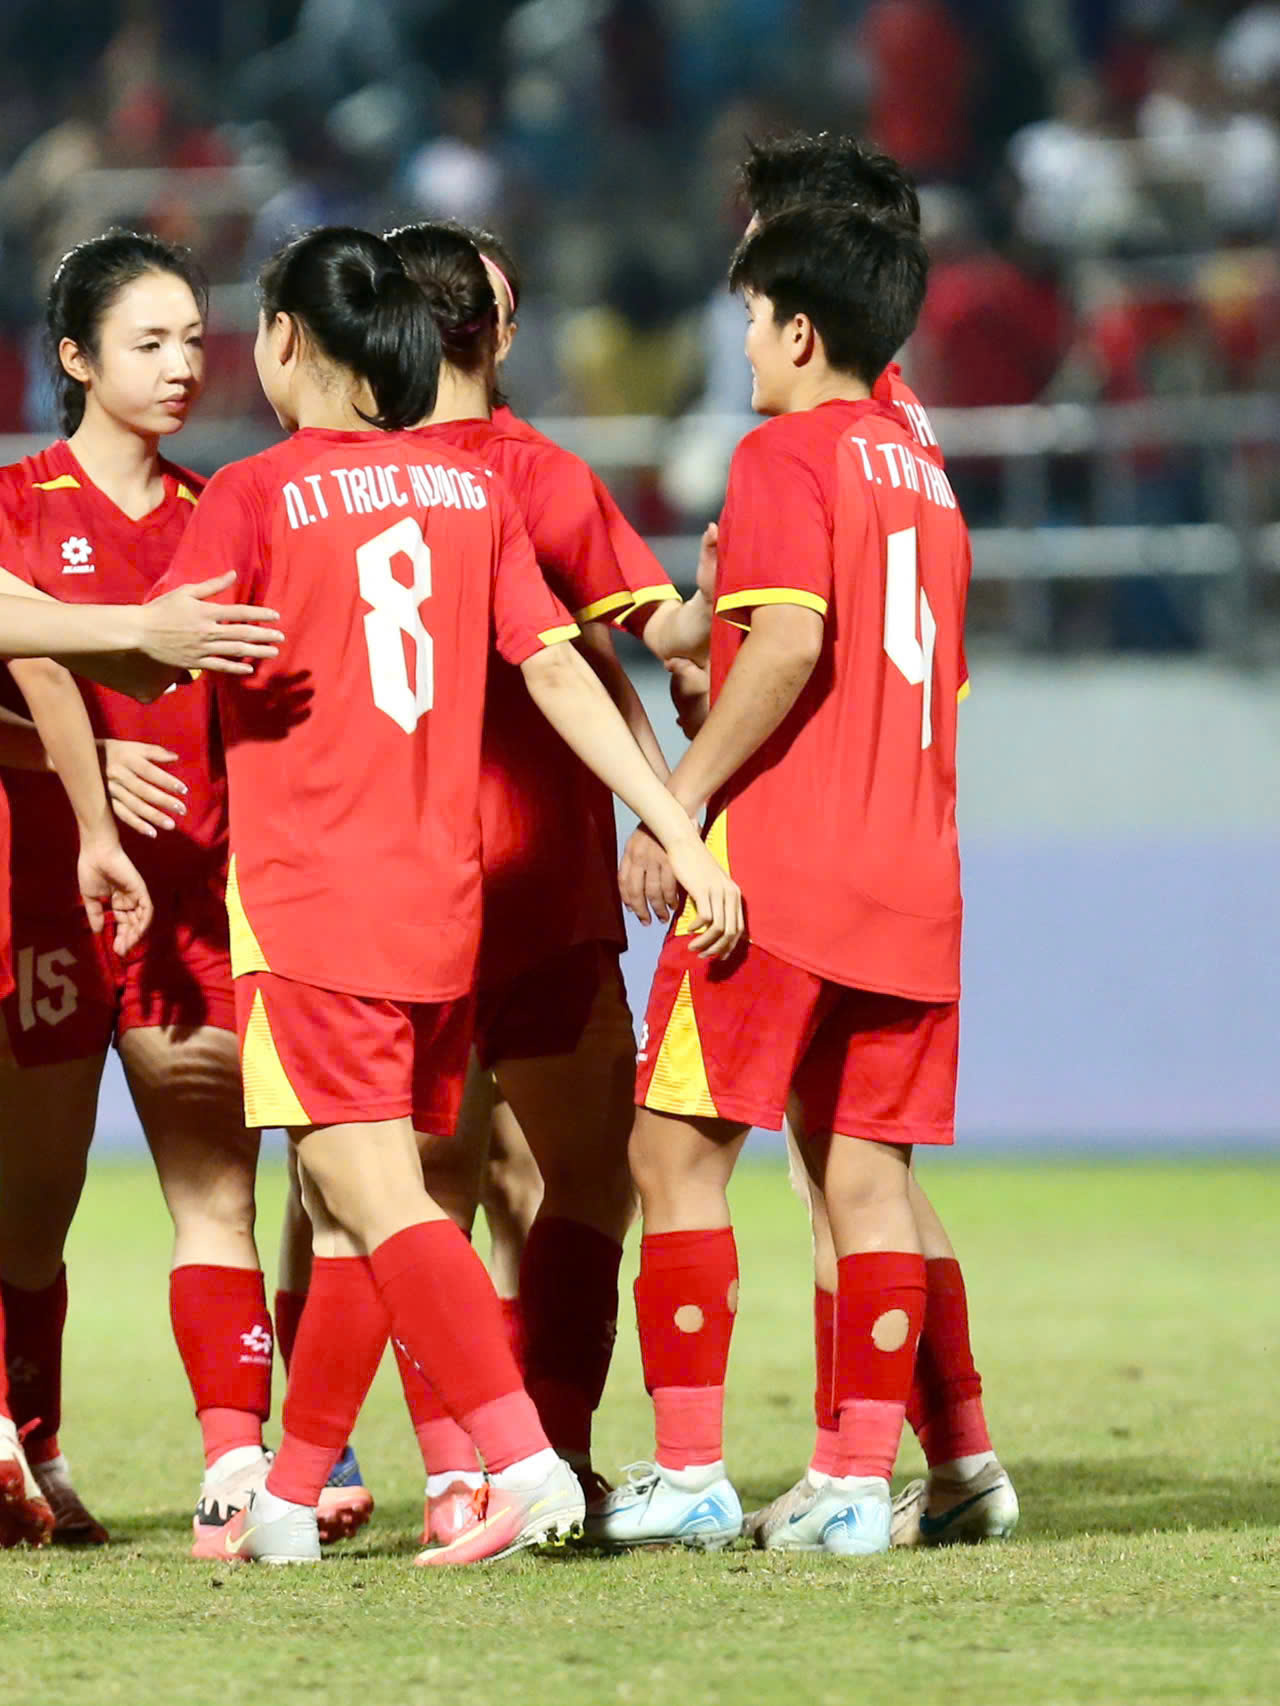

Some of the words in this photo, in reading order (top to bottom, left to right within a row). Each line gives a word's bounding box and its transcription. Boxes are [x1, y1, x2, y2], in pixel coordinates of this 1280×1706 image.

[330, 464, 409, 514] TRUC
[355, 515, 435, 735] 8
[883, 526, 937, 751] 4
[18, 945, 79, 1032] 15
